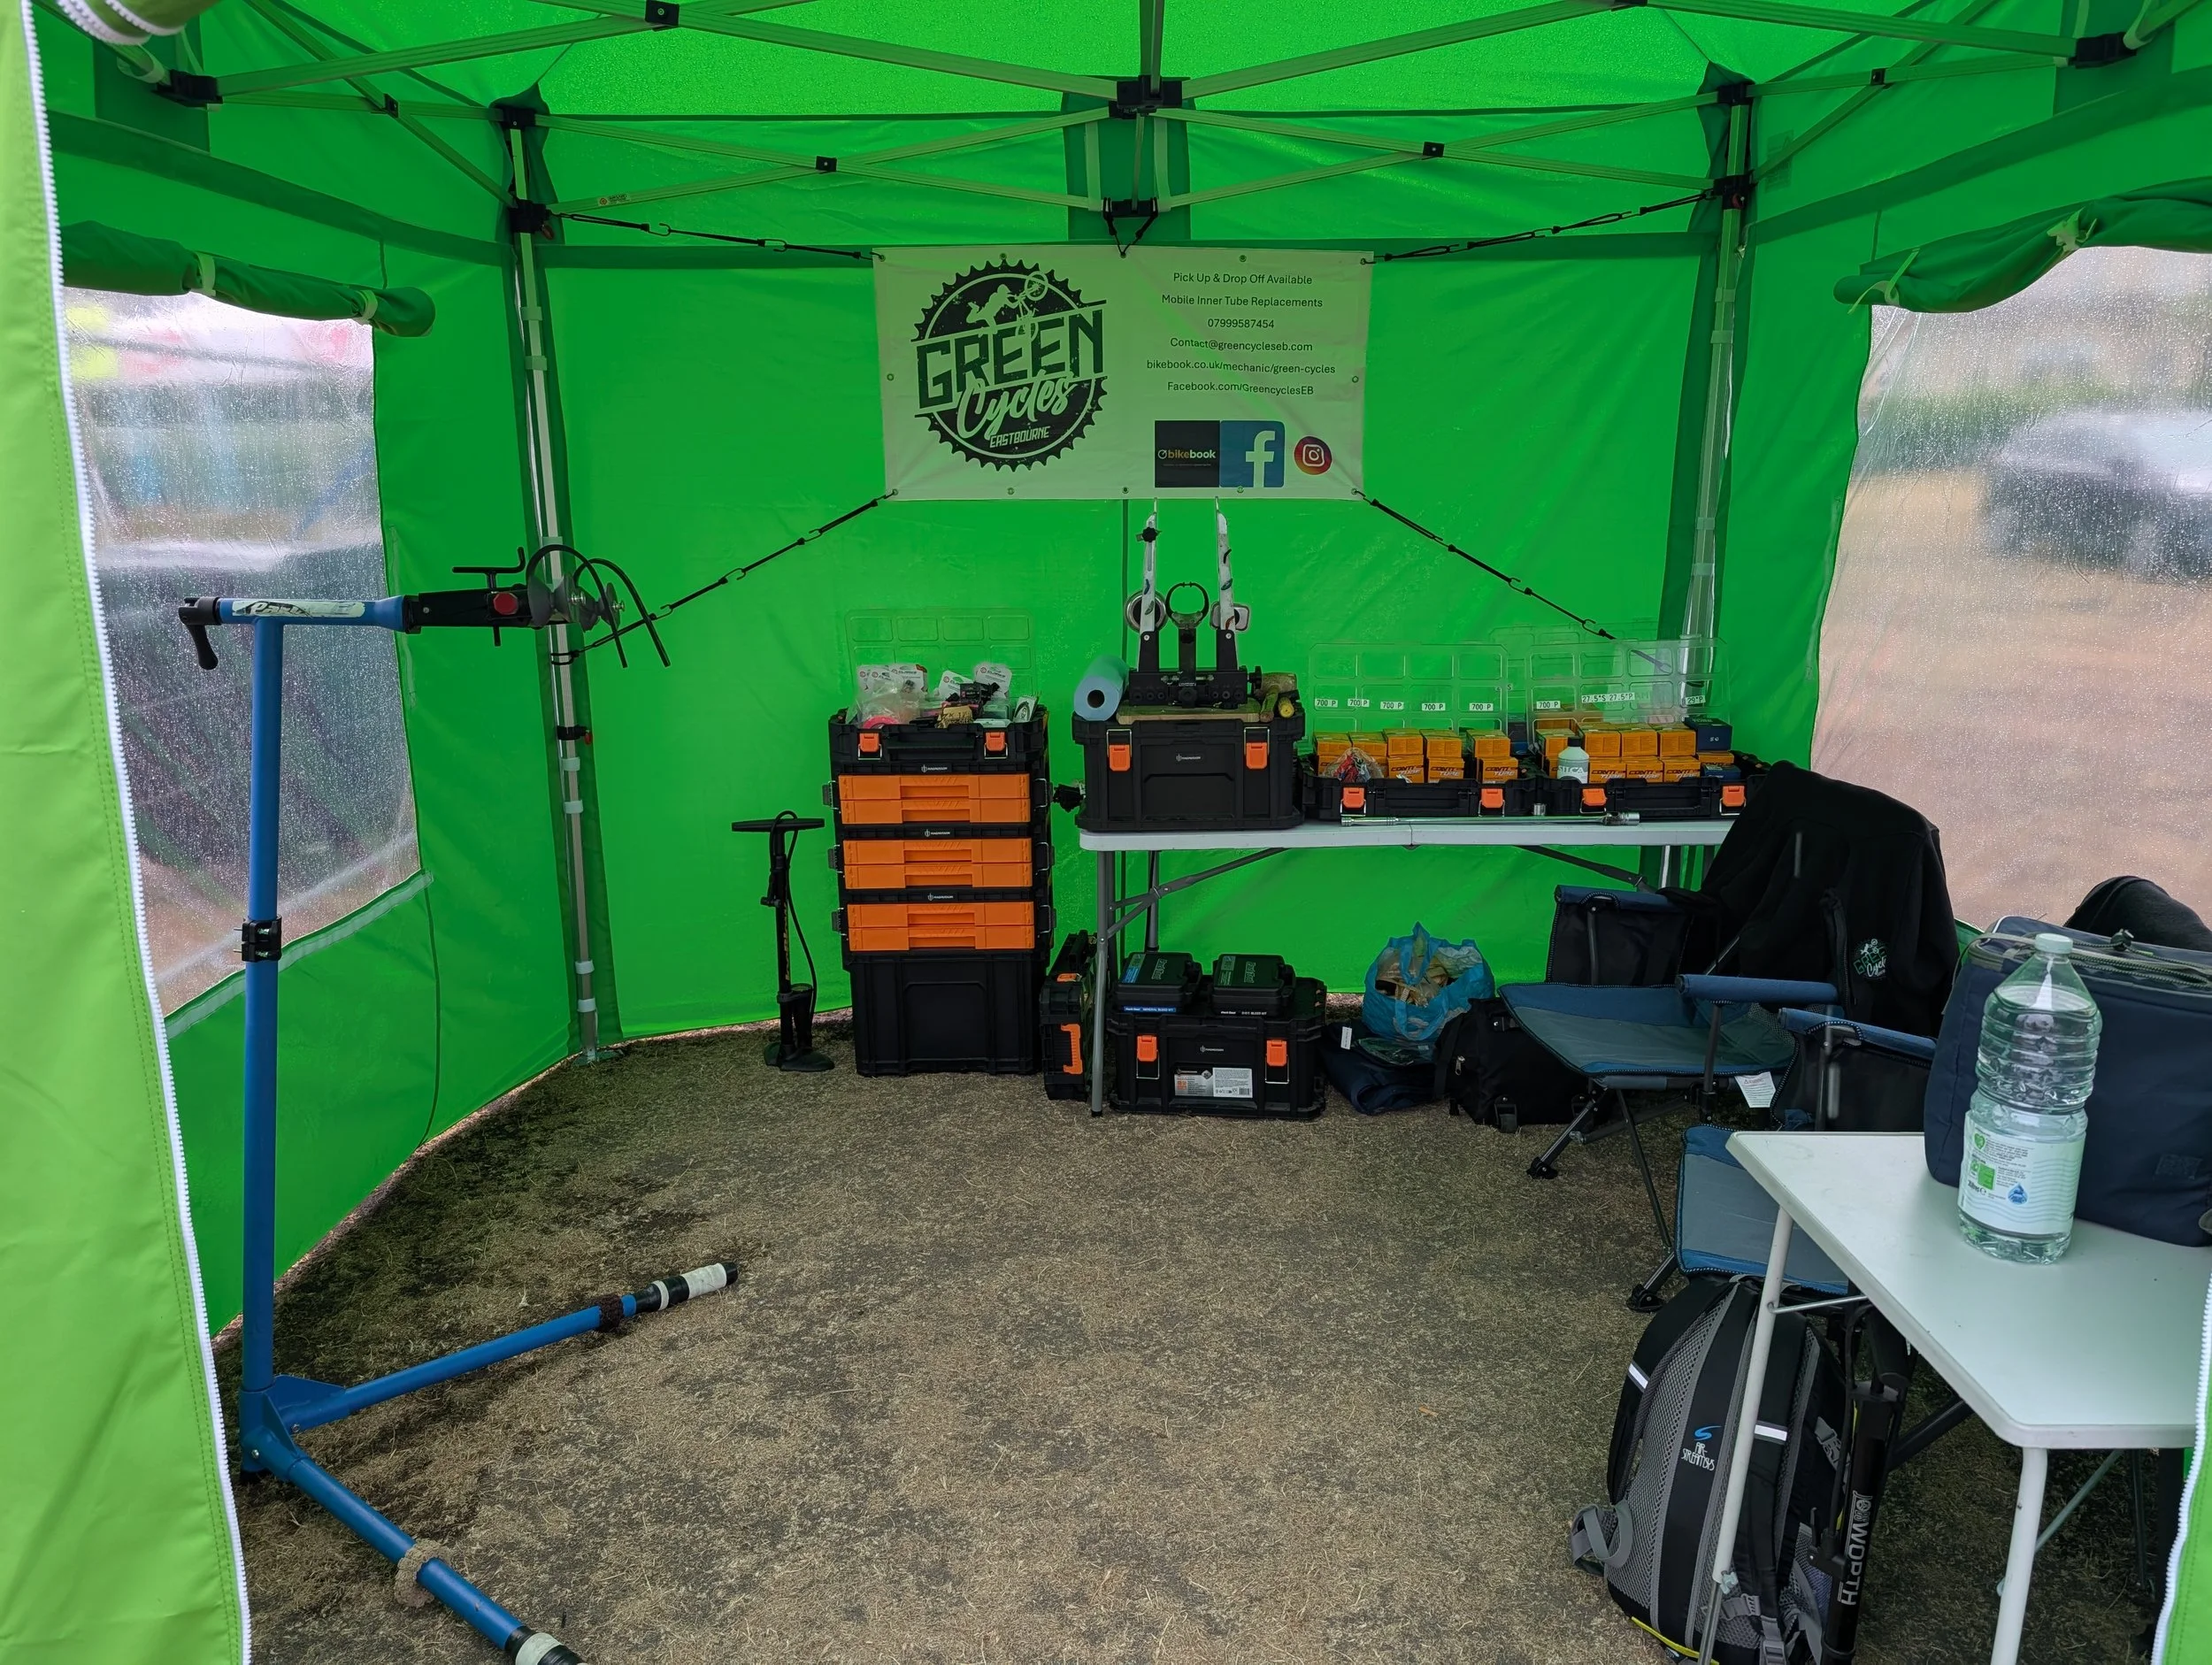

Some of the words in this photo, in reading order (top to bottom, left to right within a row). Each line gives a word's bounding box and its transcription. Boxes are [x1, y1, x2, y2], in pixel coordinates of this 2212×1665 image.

[1173, 272, 1194, 282] Pick
[1196, 273, 1211, 285] Up
[1213, 273, 1221, 283] &
[1223, 273, 1248, 285] Drop
[1249, 274, 1265, 284] Off
[1266, 274, 1313, 285] Available
[1162, 295, 1194, 305] Mobile
[1197, 295, 1223, 305] Inner
[1225, 296, 1249, 306] Tube
[1251, 296, 1323, 308] Replacements
[1208, 318, 1275, 329] 07999587454
[1170, 337, 1313, 352] Contact@greencycleseb.com
[917, 309, 1104, 410] GREEN
[1147, 359, 1336, 375] bikebook.co.uk/mechanic/green-cycles
[1167, 381, 1315, 396] Facebook.com/GreencyclesEB
[956, 369, 1079, 441] Cycles
[989, 425, 1051, 449] EASTBOURNE
[1167, 449, 1217, 460] bikebook
